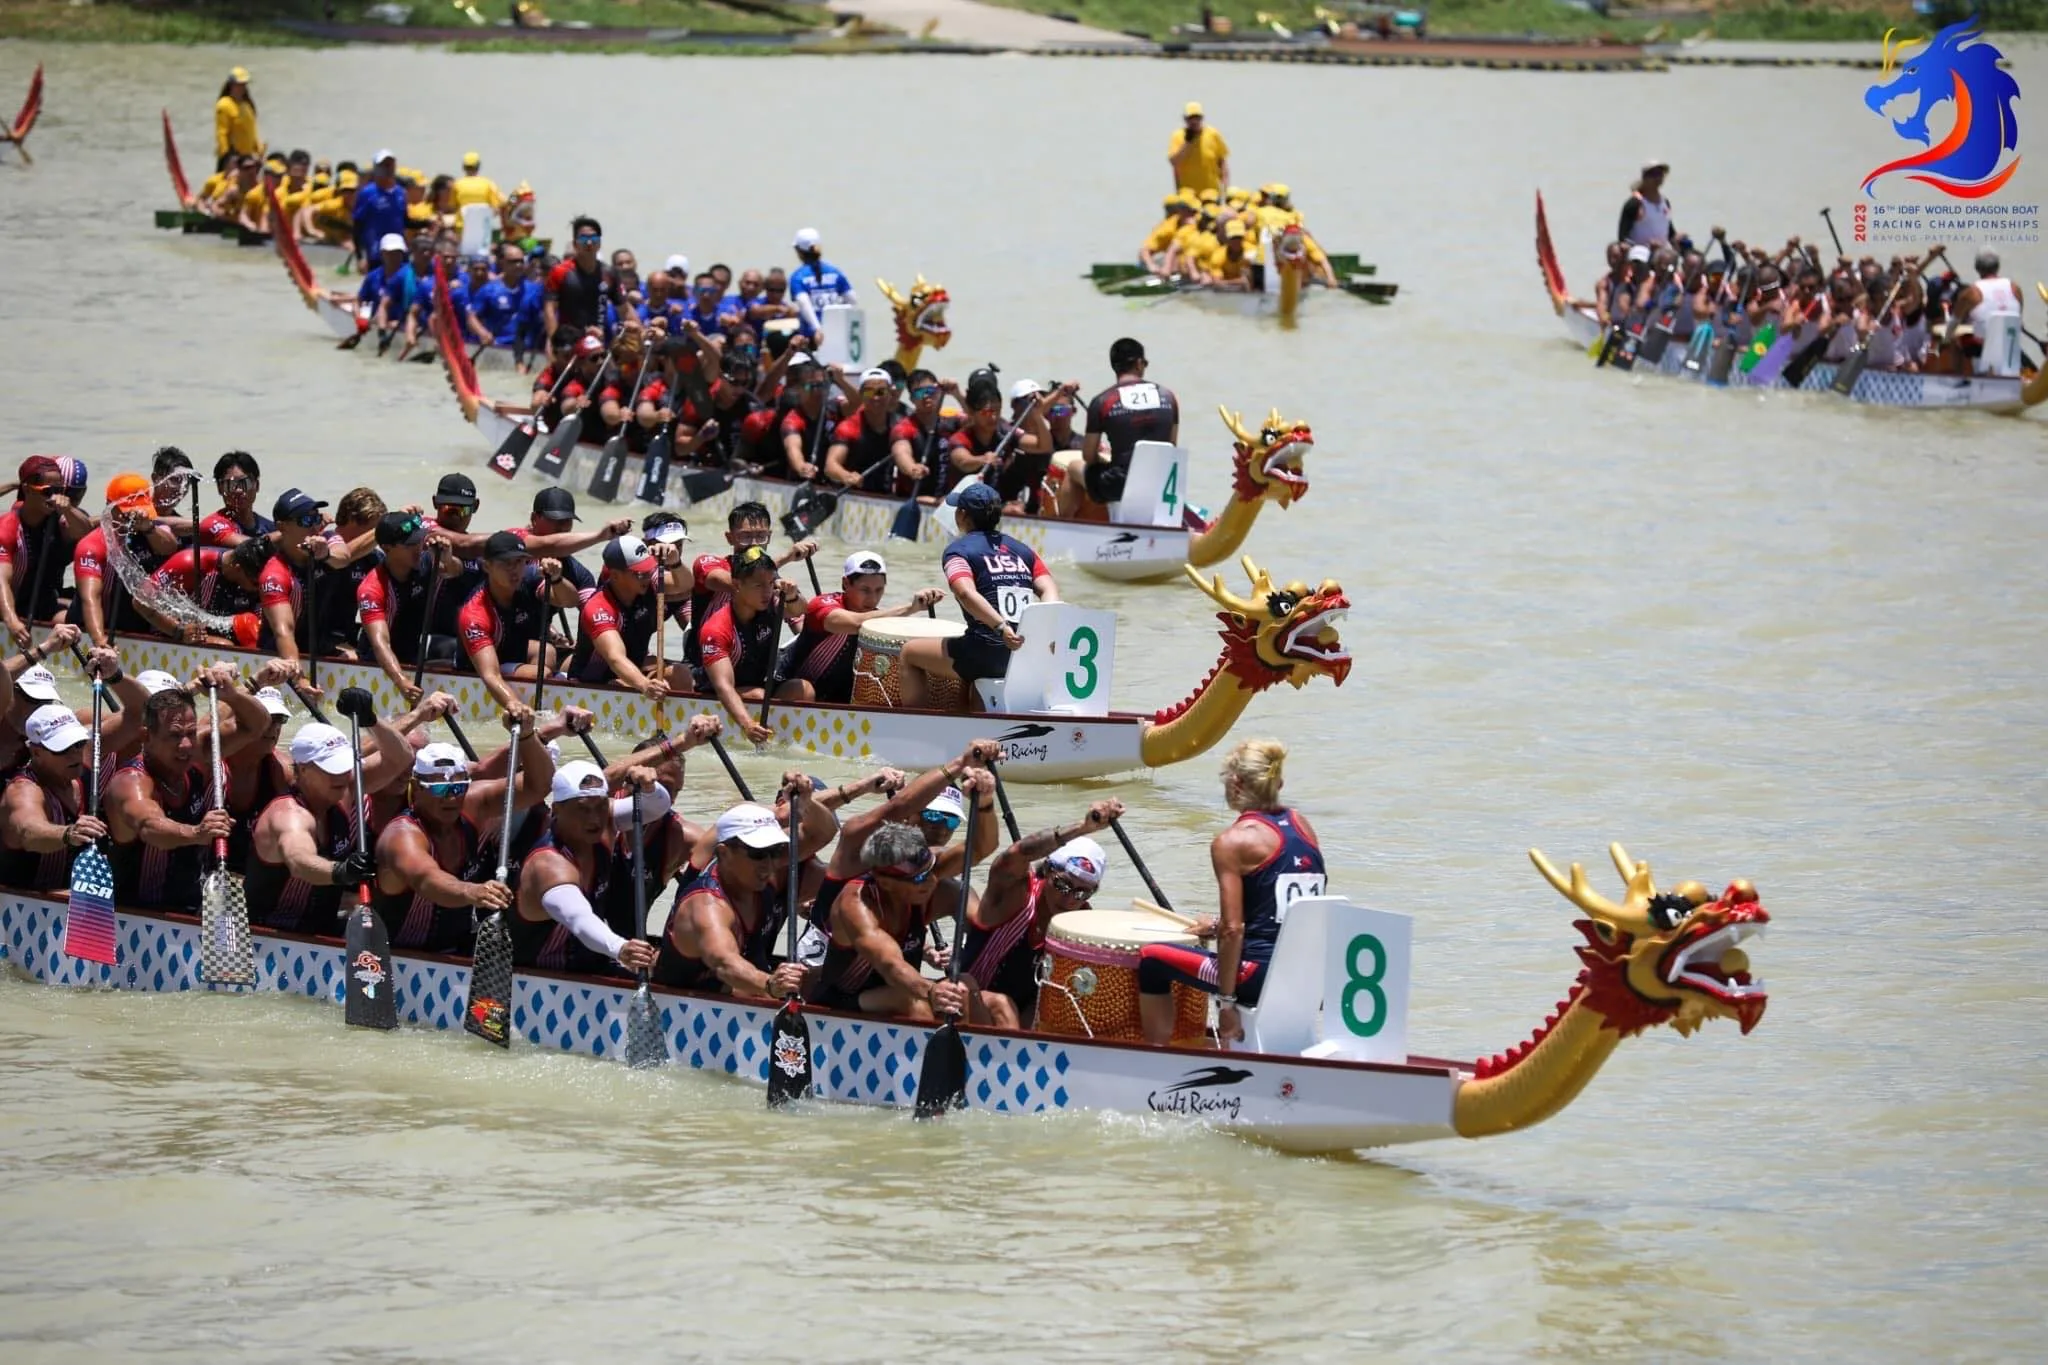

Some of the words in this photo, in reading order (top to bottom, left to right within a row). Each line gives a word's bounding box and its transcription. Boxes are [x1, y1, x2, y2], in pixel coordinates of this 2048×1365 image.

[849, 320, 861, 363] 5
[2007, 326, 2017, 369] 7
[1131, 392, 1149, 405] 21
[1162, 461, 1178, 517] 4
[80, 557, 102, 572] USA
[463, 560, 479, 571] USA
[983, 555, 1031, 574] USA
[261, 582, 284, 593] USA
[359, 600, 379, 611] USA
[592, 613, 616, 624] USA
[1065, 626, 1099, 700] 3
[1011, 742, 1048, 761] Racing
[507, 860, 521, 870] SA
[73, 880, 114, 900] USA
[1341, 933, 1388, 1038] 8
[1190, 1090, 1243, 1119] Racing
